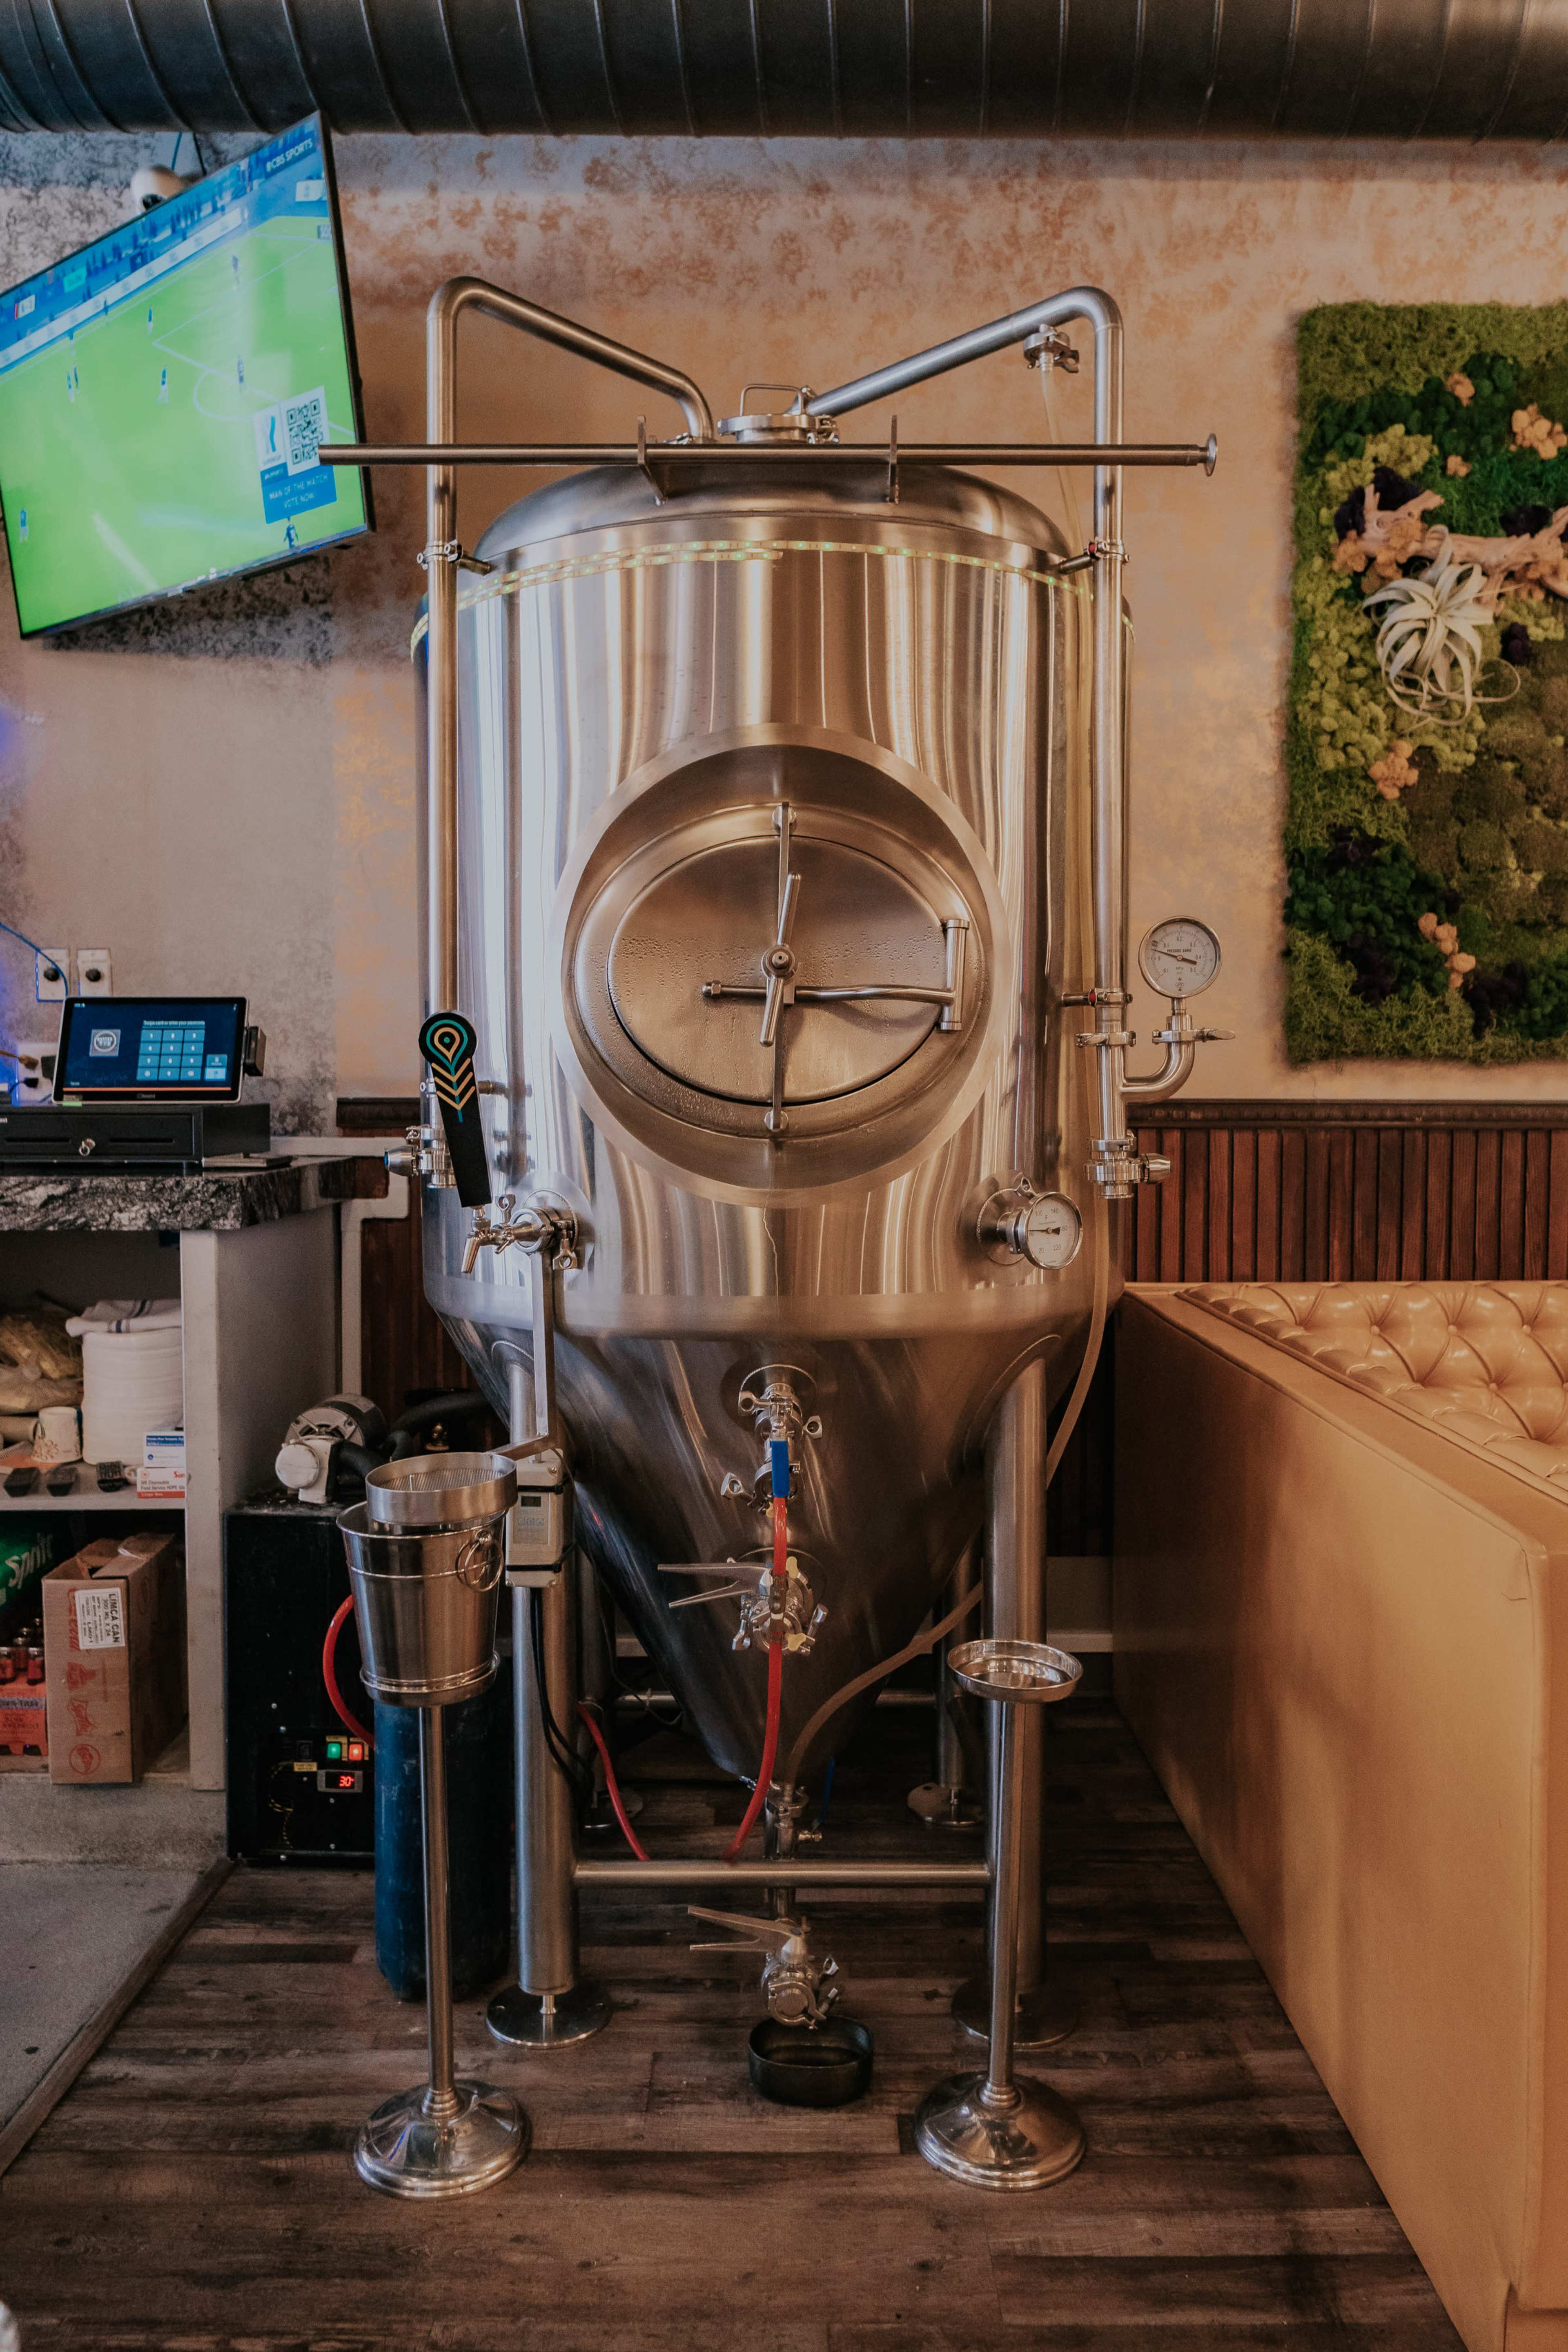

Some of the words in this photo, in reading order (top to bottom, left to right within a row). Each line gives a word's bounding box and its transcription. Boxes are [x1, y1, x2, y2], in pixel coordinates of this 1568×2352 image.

[271, 154, 285, 168] CBS
[285, 138, 313, 161] SPORTS
[269, 490, 283, 500] MAN
[285, 485, 291, 495] OF
[294, 481, 305, 490] THE
[307, 473, 328, 486] MATCH
[284, 496, 298, 508] VOTE
[301, 492, 314, 502] NOW
[109, 1594, 118, 1621] LIMCA
[111, 1624, 120, 1643] CAN
